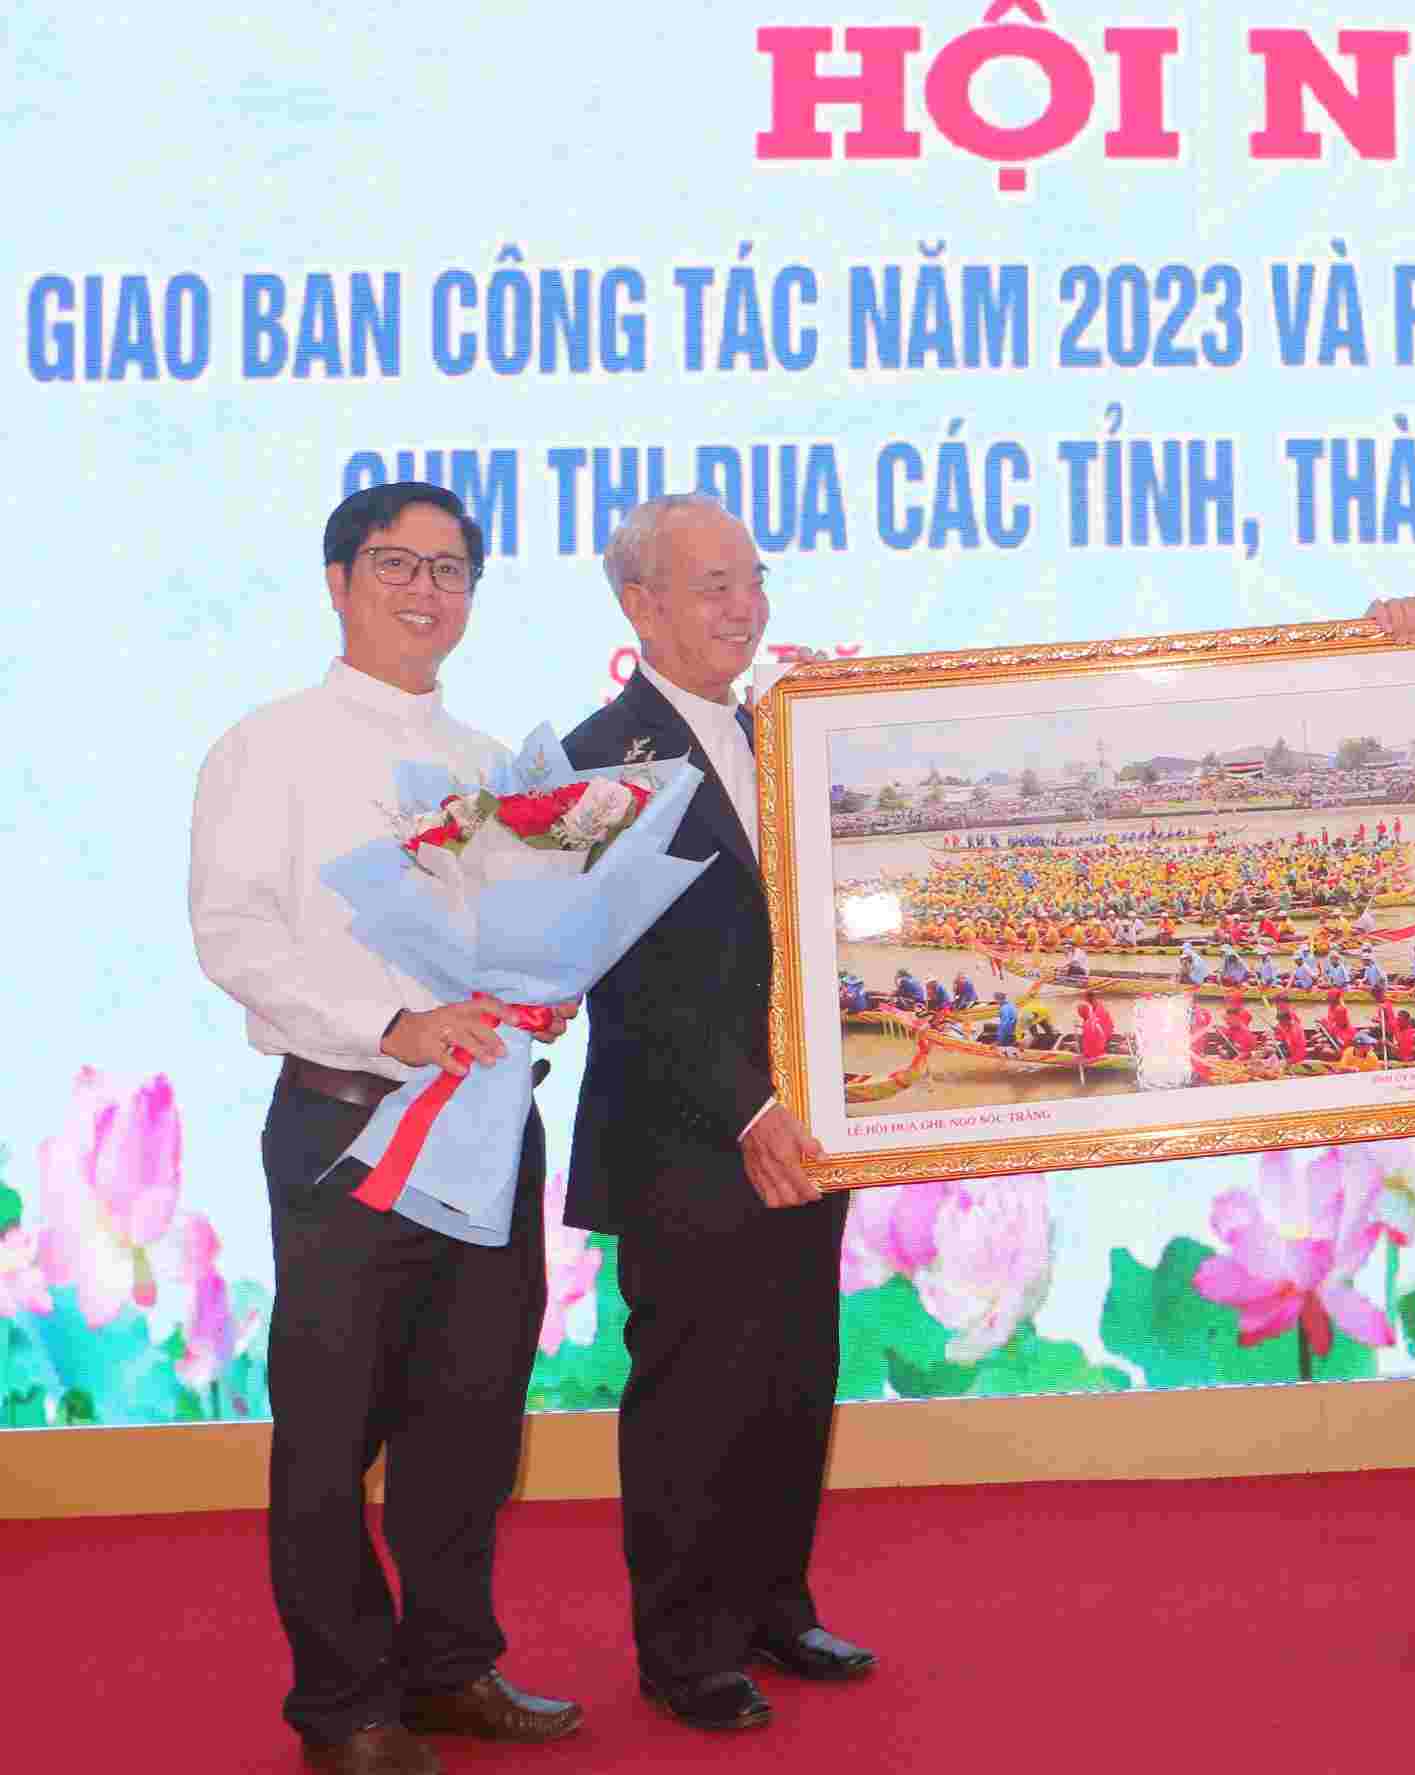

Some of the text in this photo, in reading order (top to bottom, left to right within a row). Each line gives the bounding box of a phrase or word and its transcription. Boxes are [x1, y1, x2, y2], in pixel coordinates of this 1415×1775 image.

[756, 0, 1180, 192] HỘI
[27, 273, 210, 382] GIAO
[242, 270, 401, 379] BAN
[431, 245, 647, 376] CÔNG
[673, 241, 820, 371] TÁC
[848, 240, 1030, 370] NĂM
[1058, 264, 1243, 368] 2023
[1271, 239, 1368, 367] VÀ
[877, 418, 1032, 550] CÁC
[1059, 402, 1263, 560] TỈNH,
